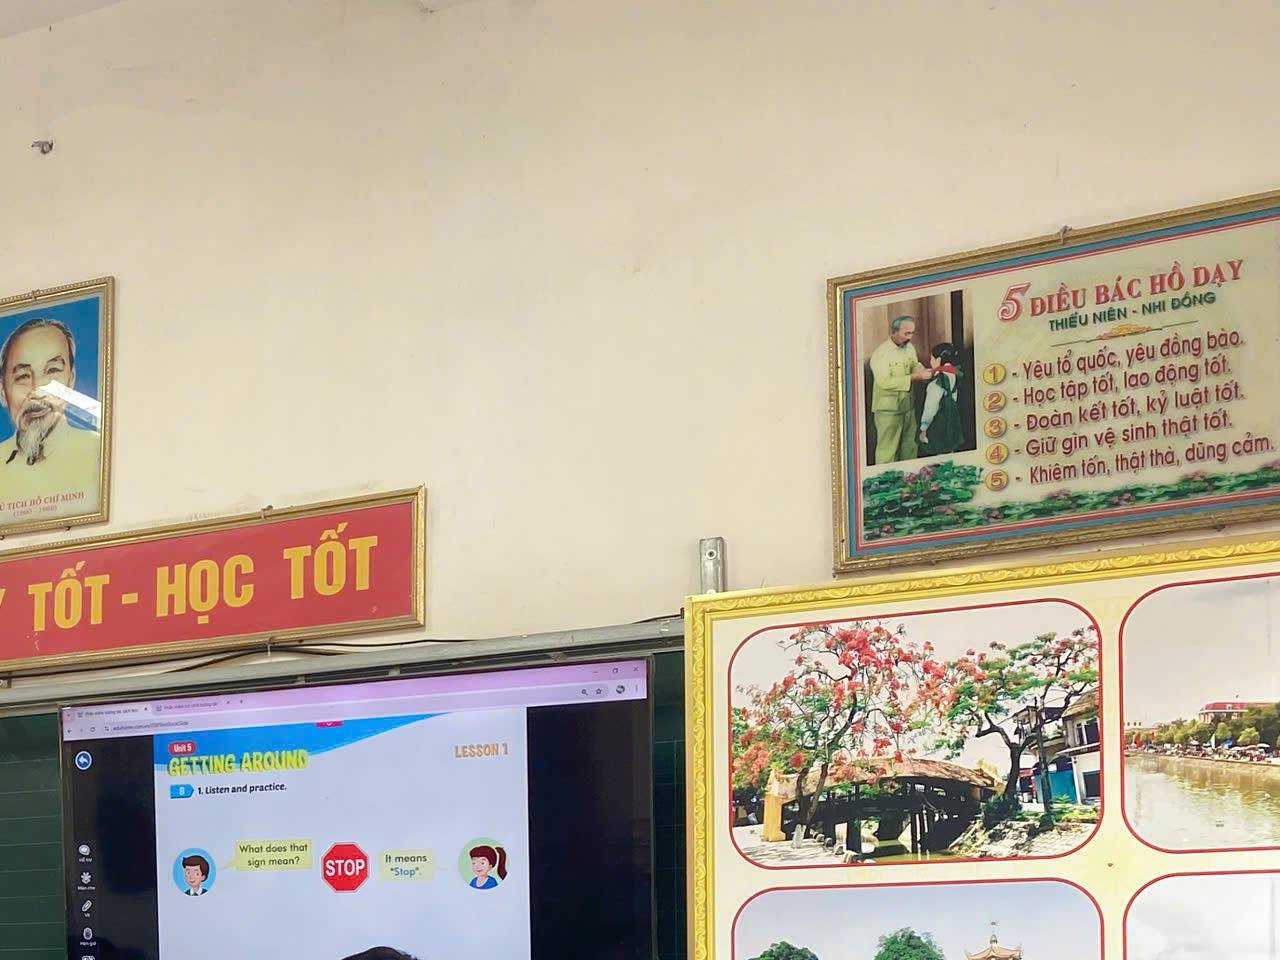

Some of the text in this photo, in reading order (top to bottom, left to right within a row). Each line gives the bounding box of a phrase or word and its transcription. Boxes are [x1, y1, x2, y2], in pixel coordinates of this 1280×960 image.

[997, 259, 1243, 321] 5 ĐIỀU BÁC HỒ DẠY
[1049, 291, 1216, 331] THIẾU NIÊN NHI ĐỒNG
[1023, 329, 1245, 379] Yêu tổ quốc, yêu đồng bào.
[1023, 355, 1231, 407] Học tập tốt, lao động tốt.
[1026, 380, 1245, 431] Đoàn kết tốt, kỷ luật tốt.
[1025, 410, 1232, 456] Giữ gìn vệ sinh thật tốt.
[1030, 432, 1274, 484] Khiêm tốn, thật thà, dũng cảm.
[7, 500, 27, 512] TỊCH
[44, 493, 60, 504] CHÍ
[61, 491, 84, 502] MINH
[28, 561, 111, 632] TỐT
[155, 554, 254, 625] HỌC
[284, 521, 378, 600] TỐT
[168, 748, 309, 777] GETTING AROUND
[173, 743, 192, 753] Unit 5
[454, 743, 509, 759] LESSON 1
[198, 782, 287, 796] 1. Listen and practice.
[239, 842, 308, 854] What does that
[247, 855, 300, 868] sign mean?
[385, 854, 428, 864] It means
[325, 859, 365, 877] STOP
